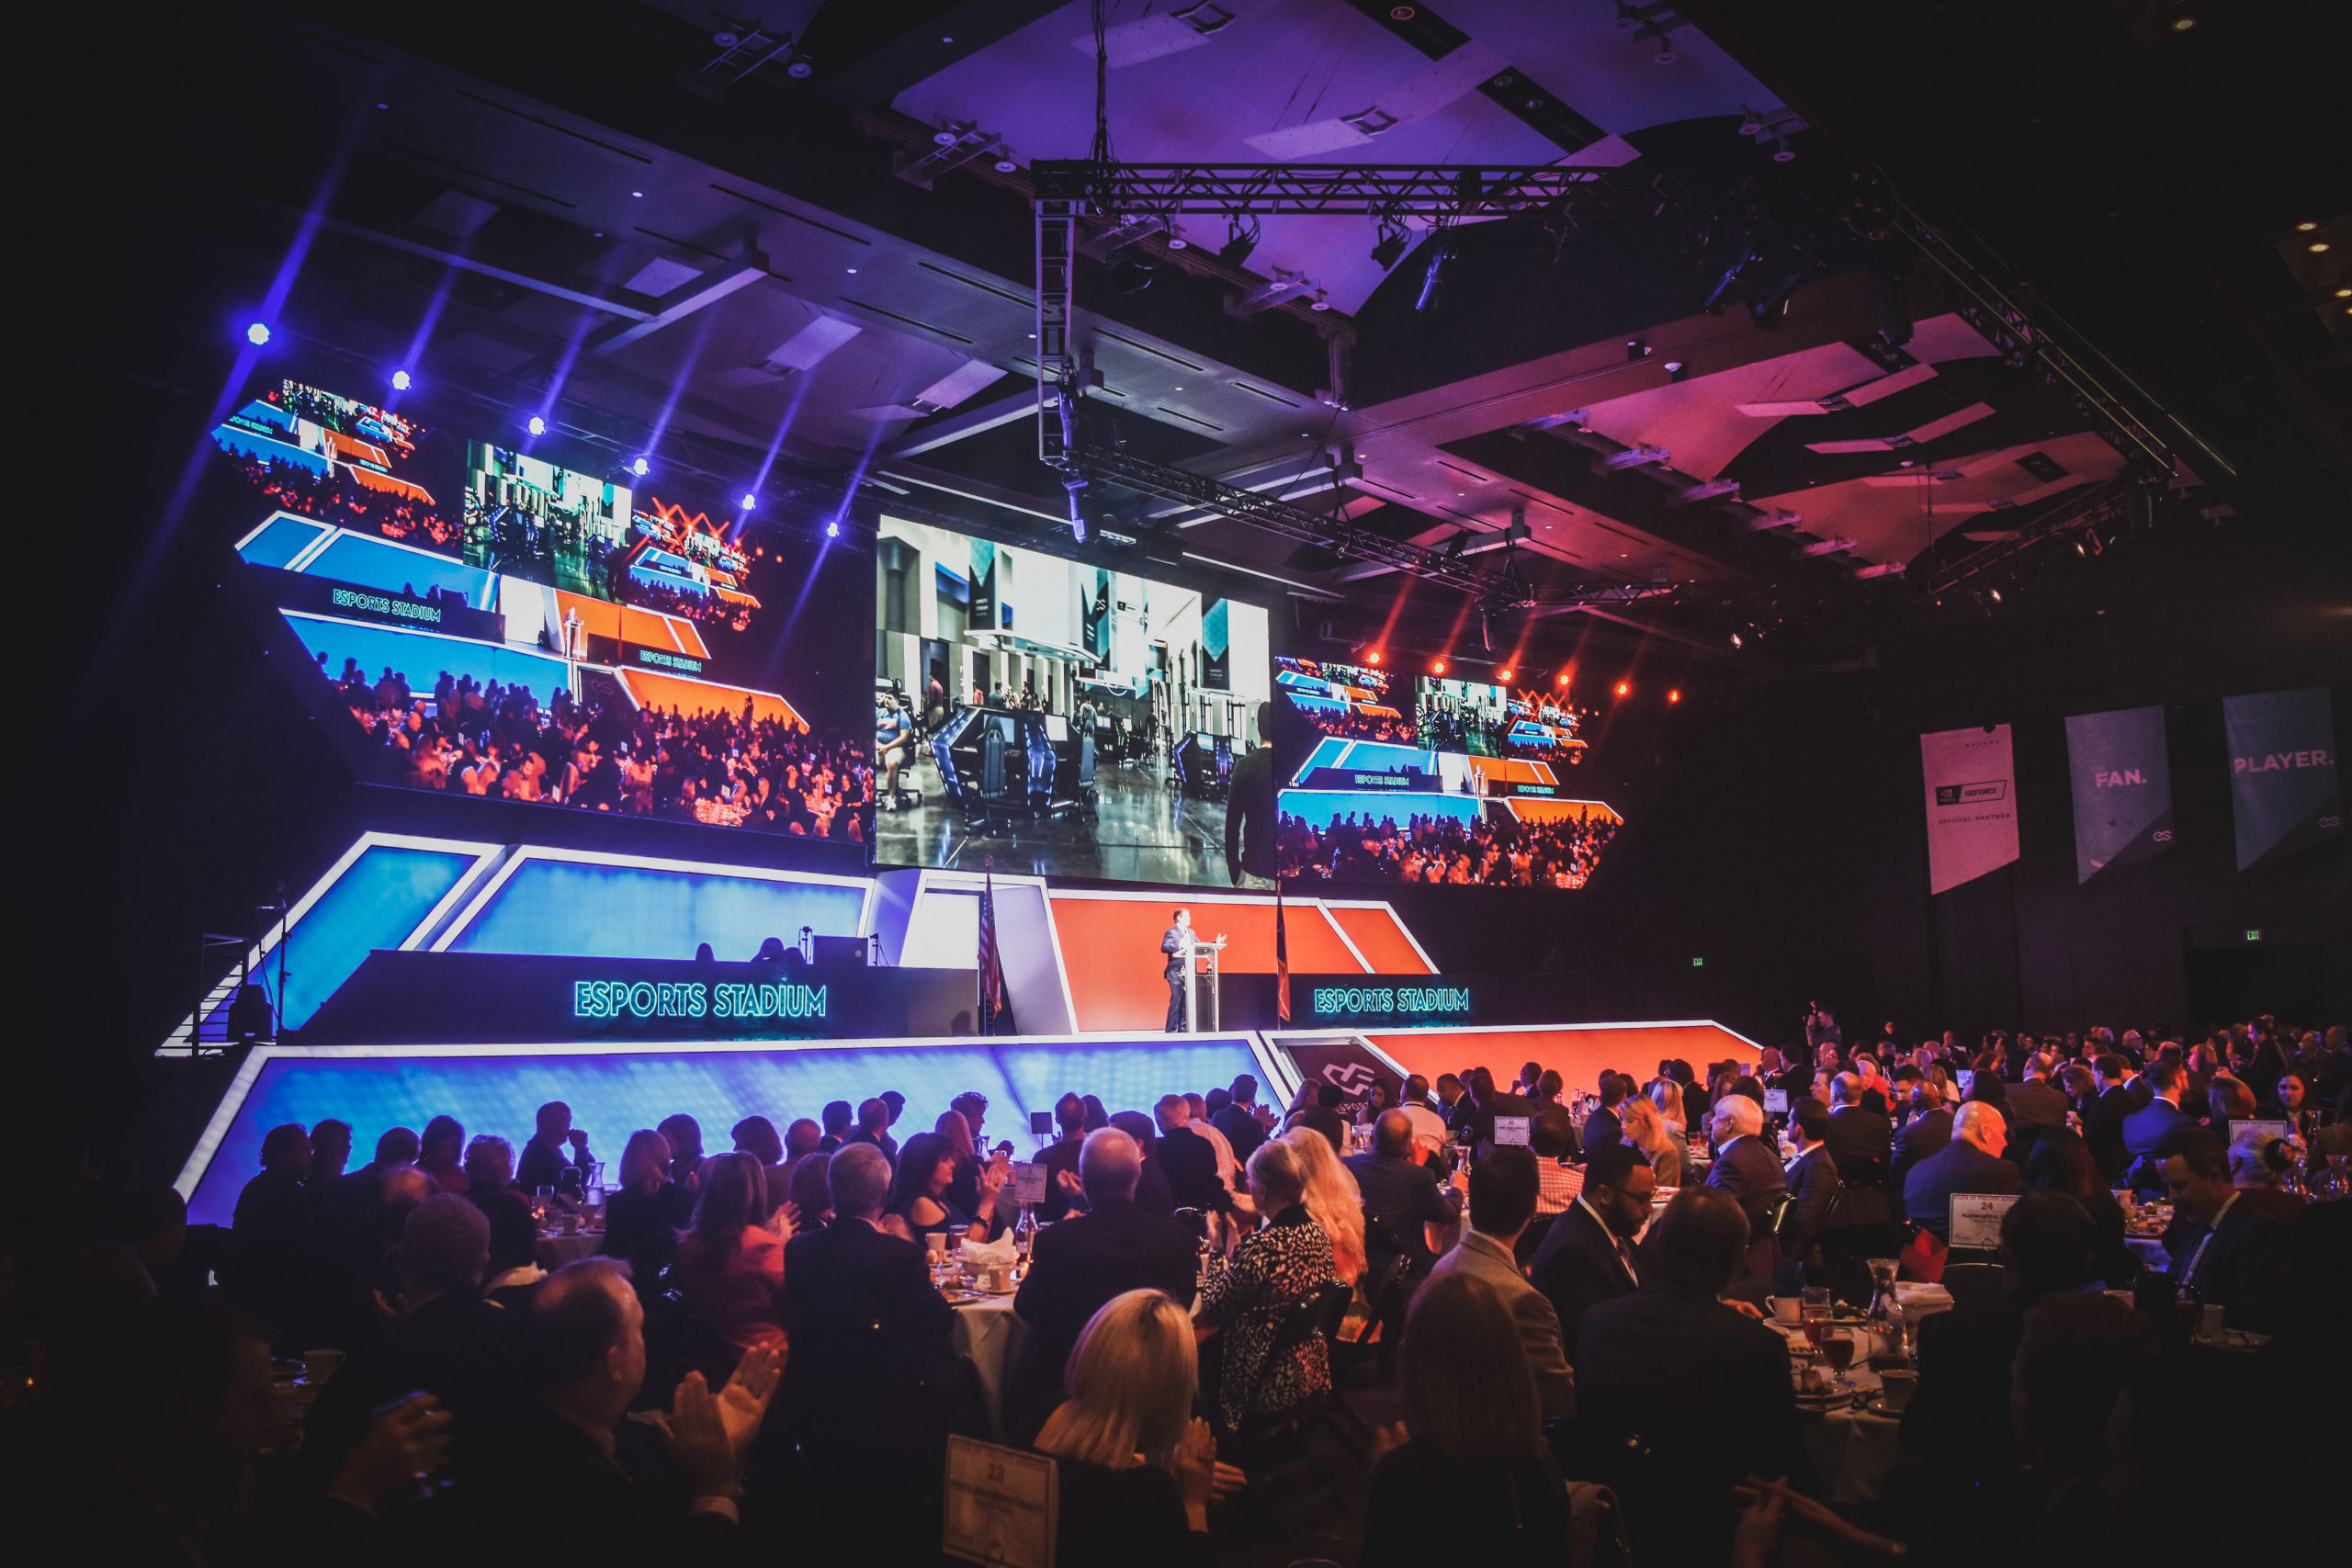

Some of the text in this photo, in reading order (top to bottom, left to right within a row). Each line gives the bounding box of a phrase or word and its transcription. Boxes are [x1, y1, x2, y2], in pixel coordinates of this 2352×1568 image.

[332, 588, 442, 623] ESPORTS STADIUM
[2233, 750, 2335, 774] PLAYER.
[2095, 769, 2148, 789] FAN.
[1964, 787, 1997, 797] GEFORCE
[1974, 813, 2011, 822] PARTNER
[574, 980, 827, 1018] ESPORTS STADIUM
[1314, 987, 1469, 1013] ESPORTS STADIUM
[1980, 1201, 1994, 1211] 24
